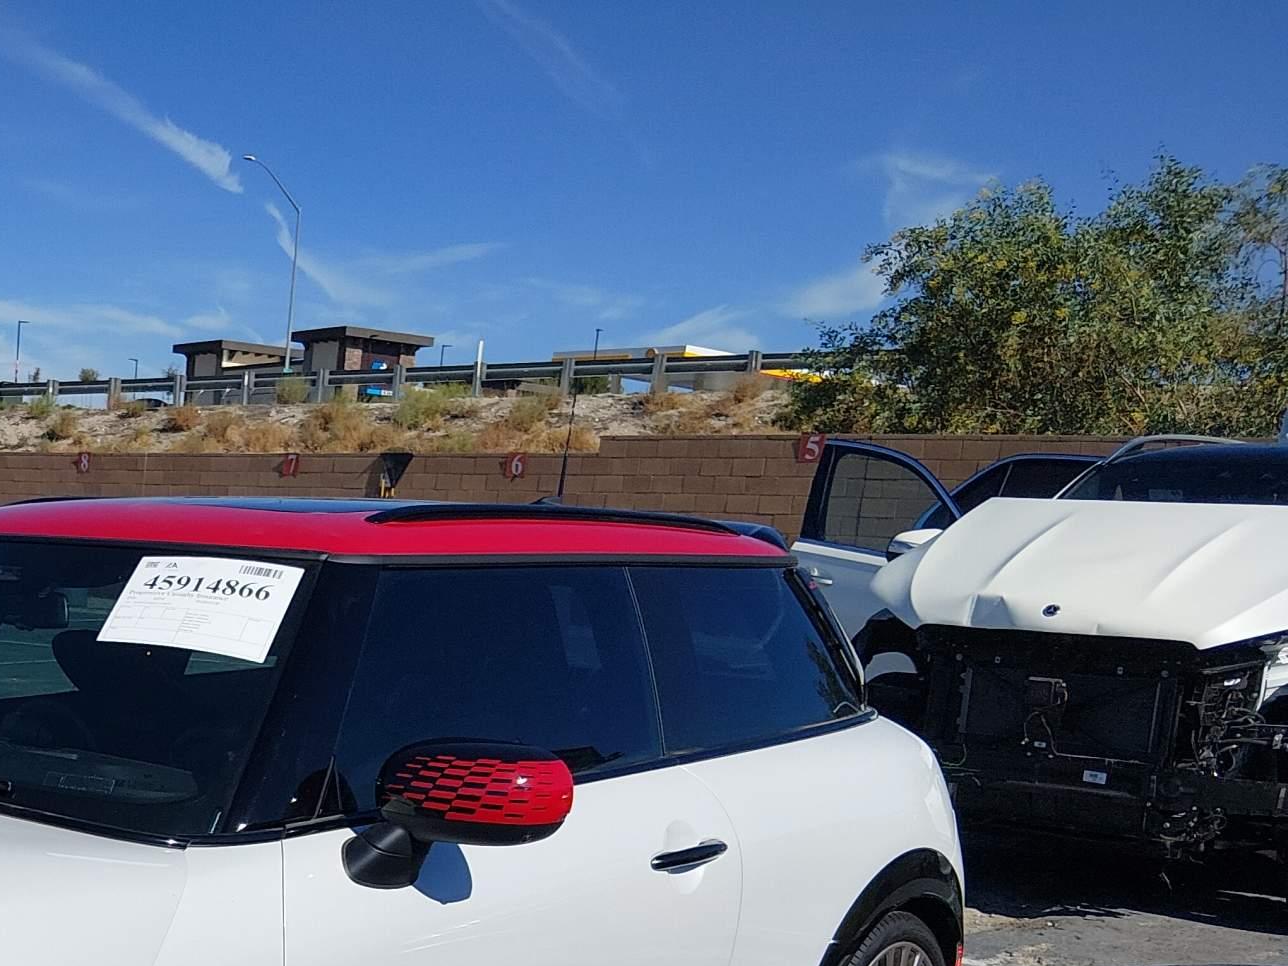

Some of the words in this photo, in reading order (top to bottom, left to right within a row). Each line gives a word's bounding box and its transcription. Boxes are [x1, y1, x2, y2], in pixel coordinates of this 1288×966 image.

[805, 436, 819, 459] 5
[80, 453, 89, 472] 8
[287, 454, 297, 473] 7
[511, 454, 523, 475] 6
[143, 574, 275, 601] 45914866
